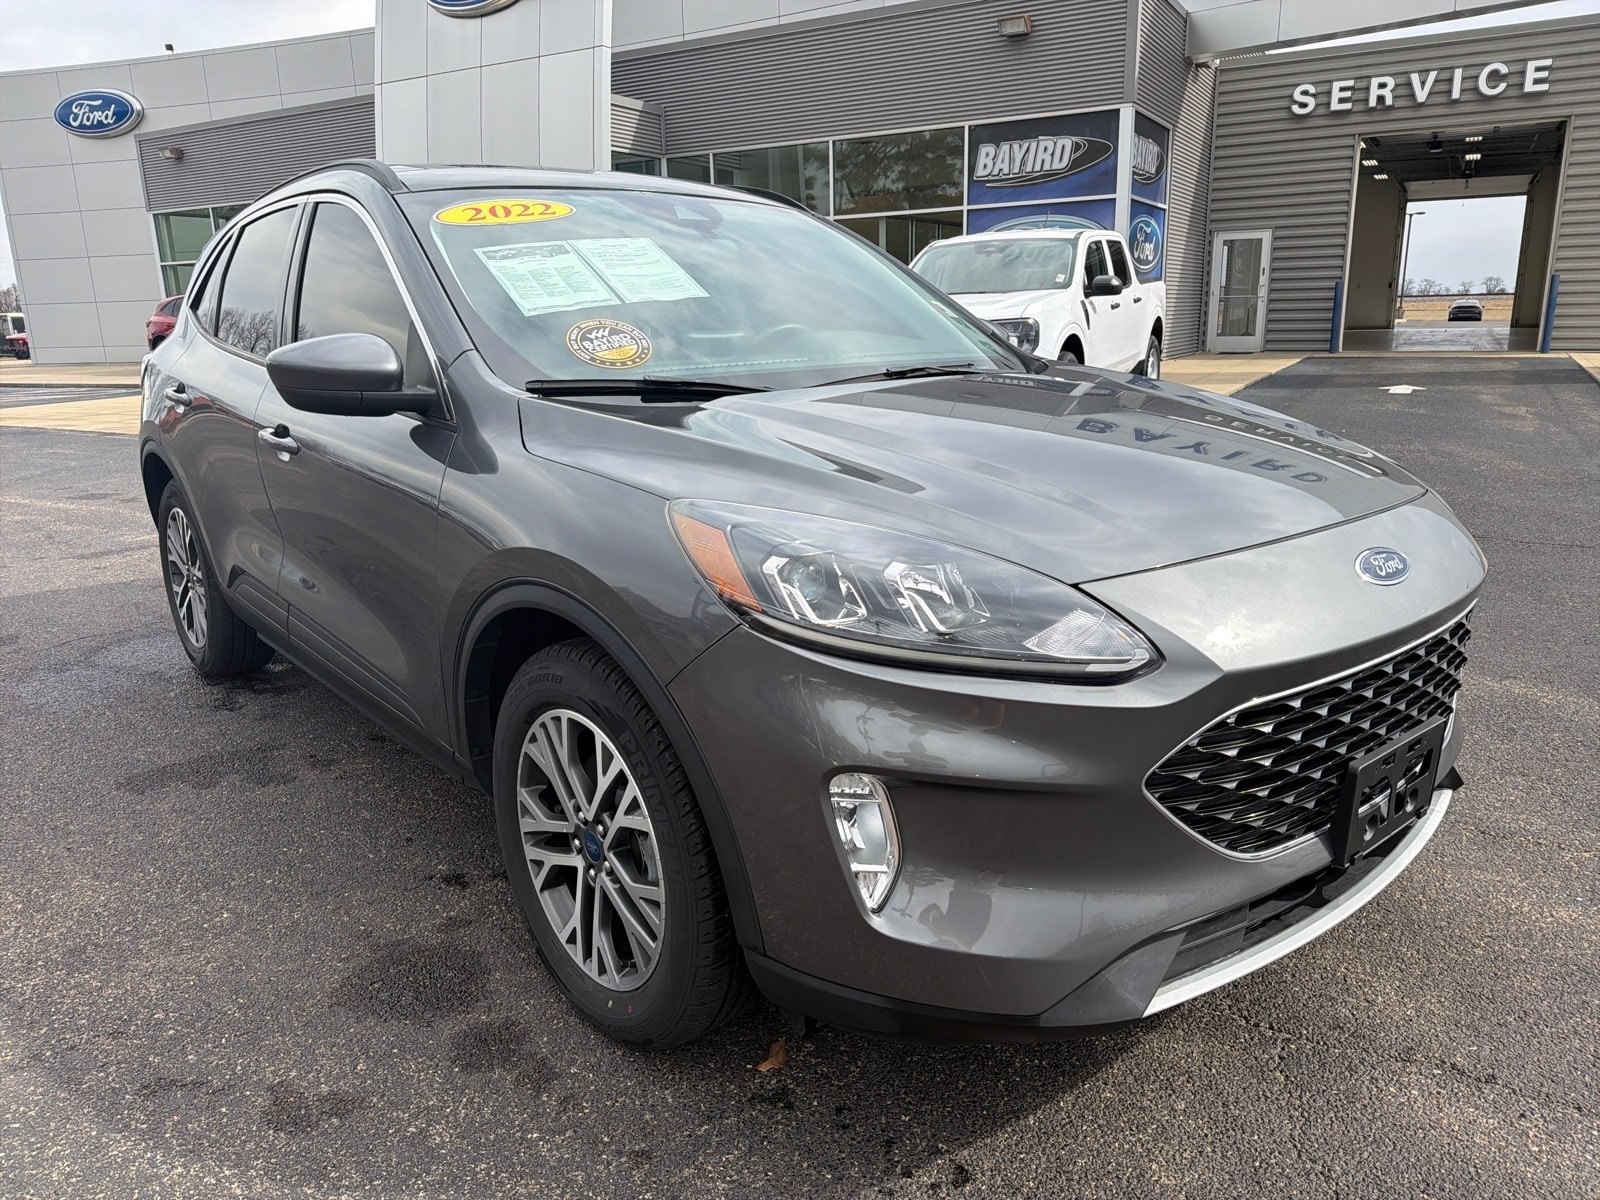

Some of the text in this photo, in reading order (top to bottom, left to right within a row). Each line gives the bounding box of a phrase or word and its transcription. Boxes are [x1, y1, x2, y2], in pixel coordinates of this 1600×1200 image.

[1290, 58, 1553, 116] SERVICE
[69, 99, 116, 127] Ford
[975, 136, 1075, 178] BAYIRD
[462, 203, 556, 221] 2022
[1134, 224, 1156, 261] Ford
[580, 320, 600, 329] WHEN
[617, 323, 632, 332] CAN
[582, 333, 631, 349] BAYIRD
[588, 339, 636, 354] CERTIFIED
[576, 350, 591, 360] WHY
[1370, 553, 1404, 576] Ford
